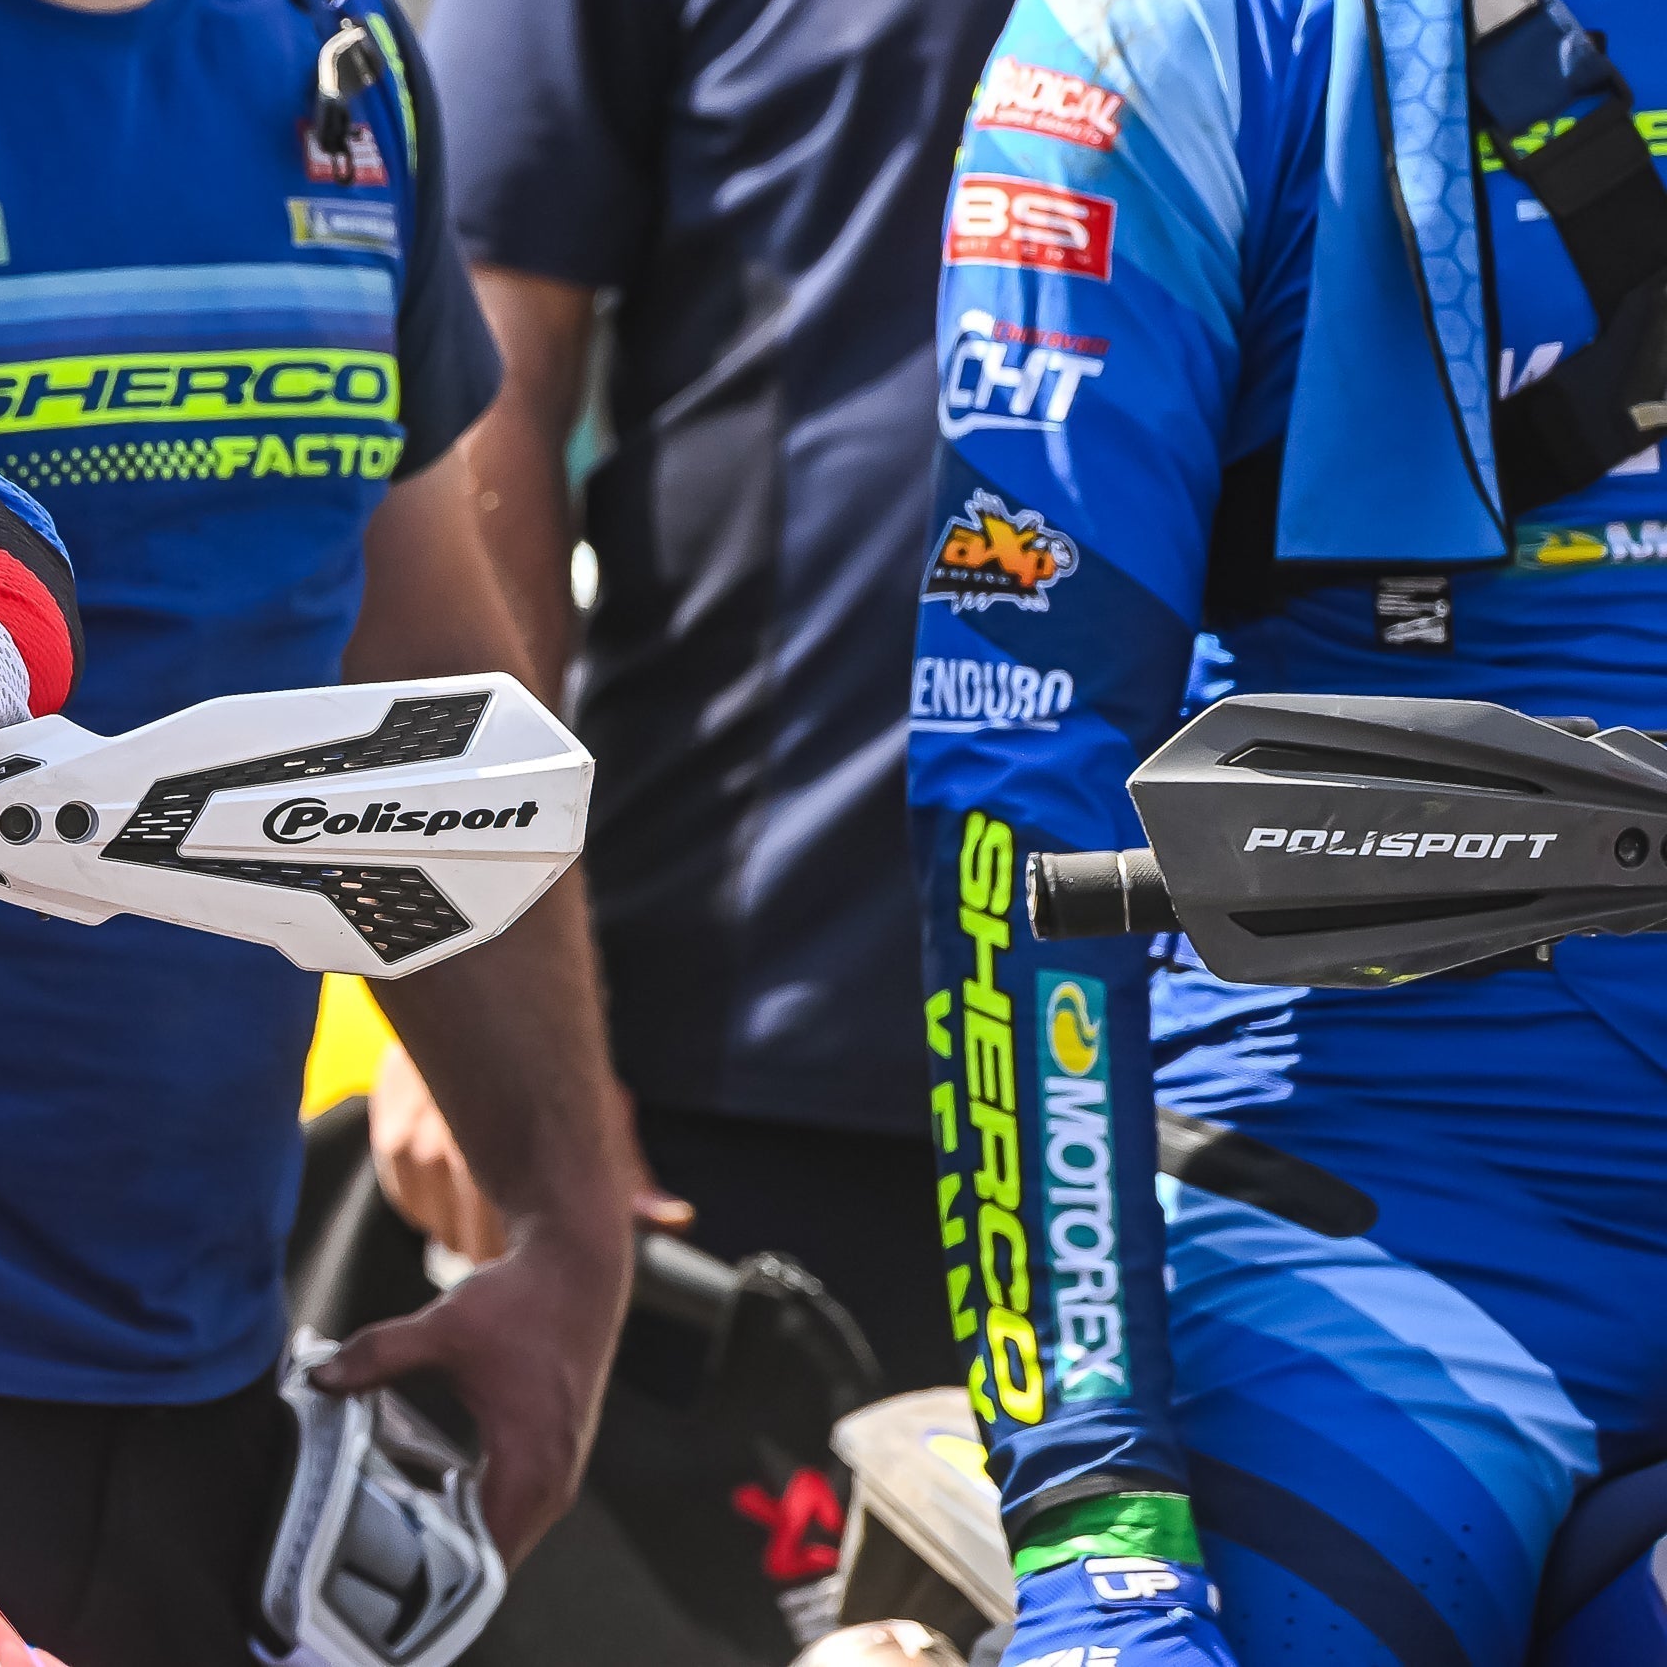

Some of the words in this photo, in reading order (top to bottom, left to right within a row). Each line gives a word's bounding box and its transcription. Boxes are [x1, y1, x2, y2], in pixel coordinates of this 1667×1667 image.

[210, 435, 402, 480] FACTO
[262, 797, 539, 845] Polisport
[1243, 827, 1558, 859] POLISPORT
[959, 810, 1043, 1425] SHERCO
[1044, 1076, 1126, 1391] MOTOREX
